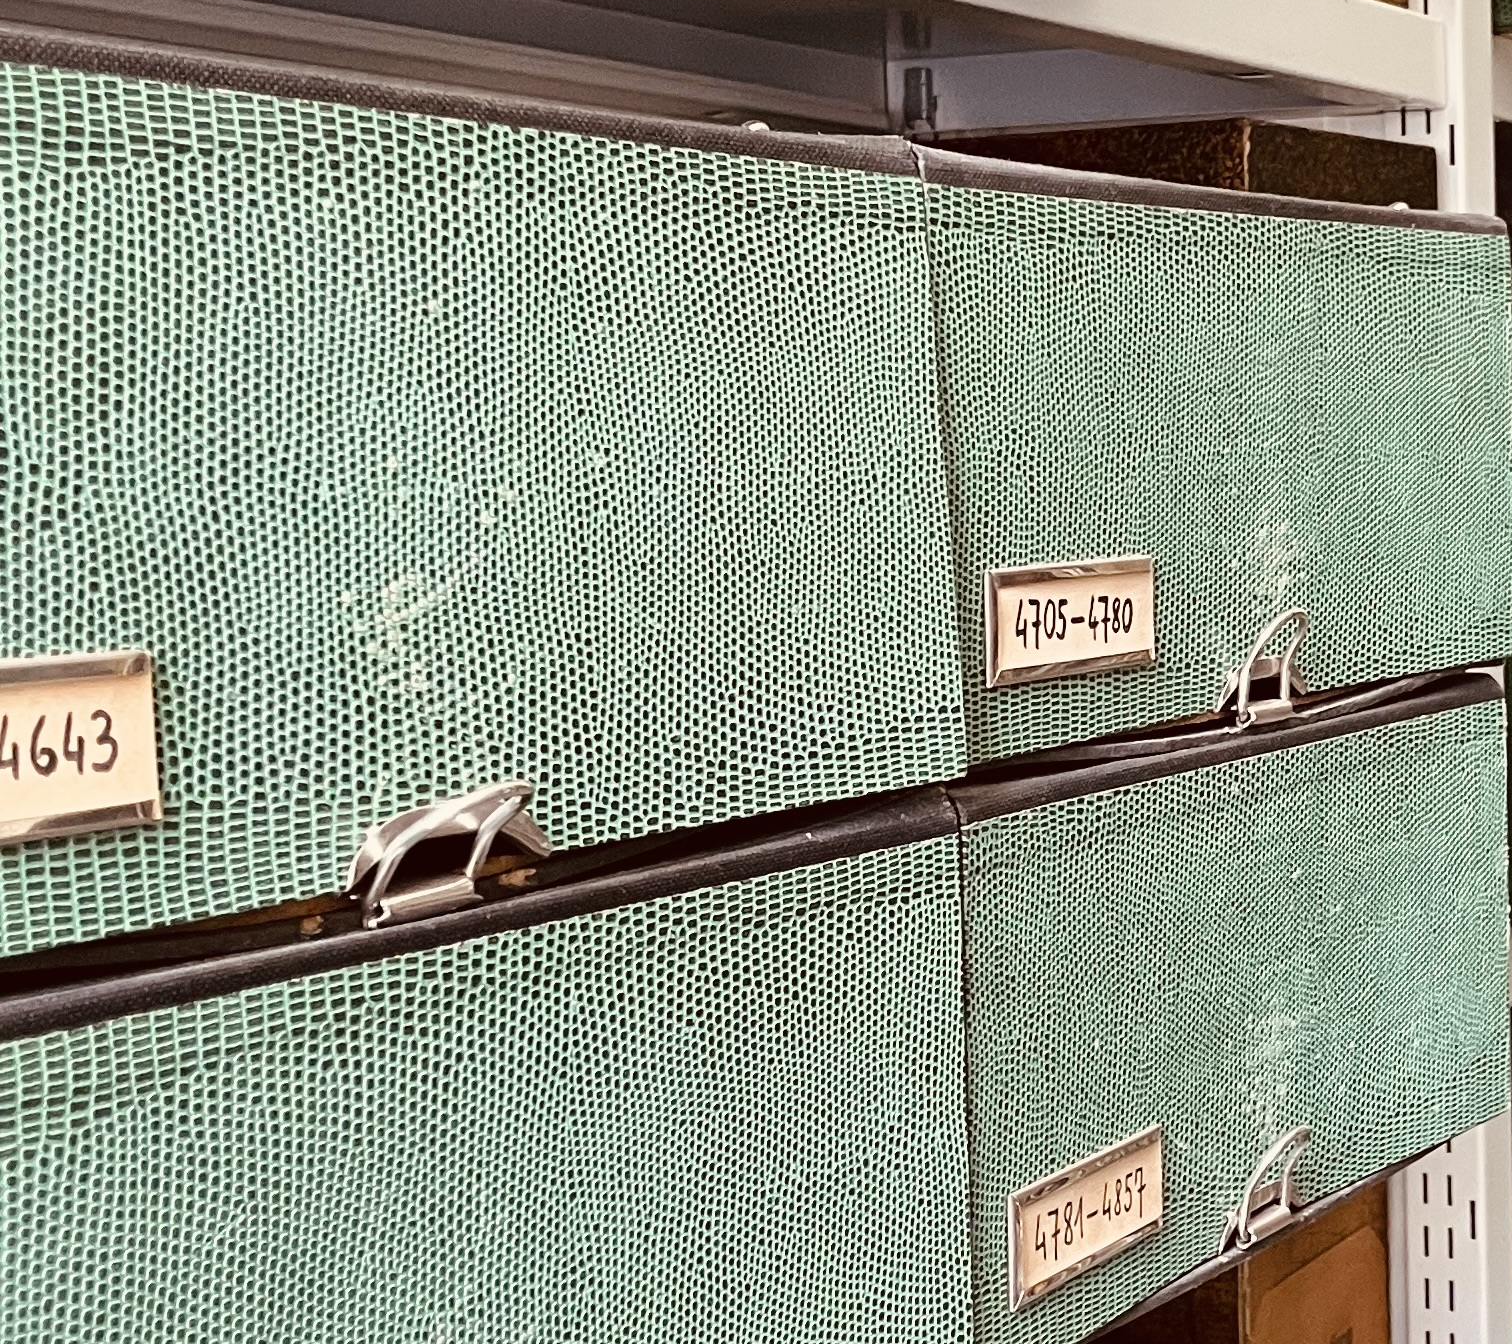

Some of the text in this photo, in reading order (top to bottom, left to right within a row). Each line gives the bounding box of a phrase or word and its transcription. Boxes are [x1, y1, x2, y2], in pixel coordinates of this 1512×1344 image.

[1015, 594, 1134, 650] 4705-4780
[0, 708, 119, 782] 4643
[1034, 1166, 1147, 1262] 4781-4857
